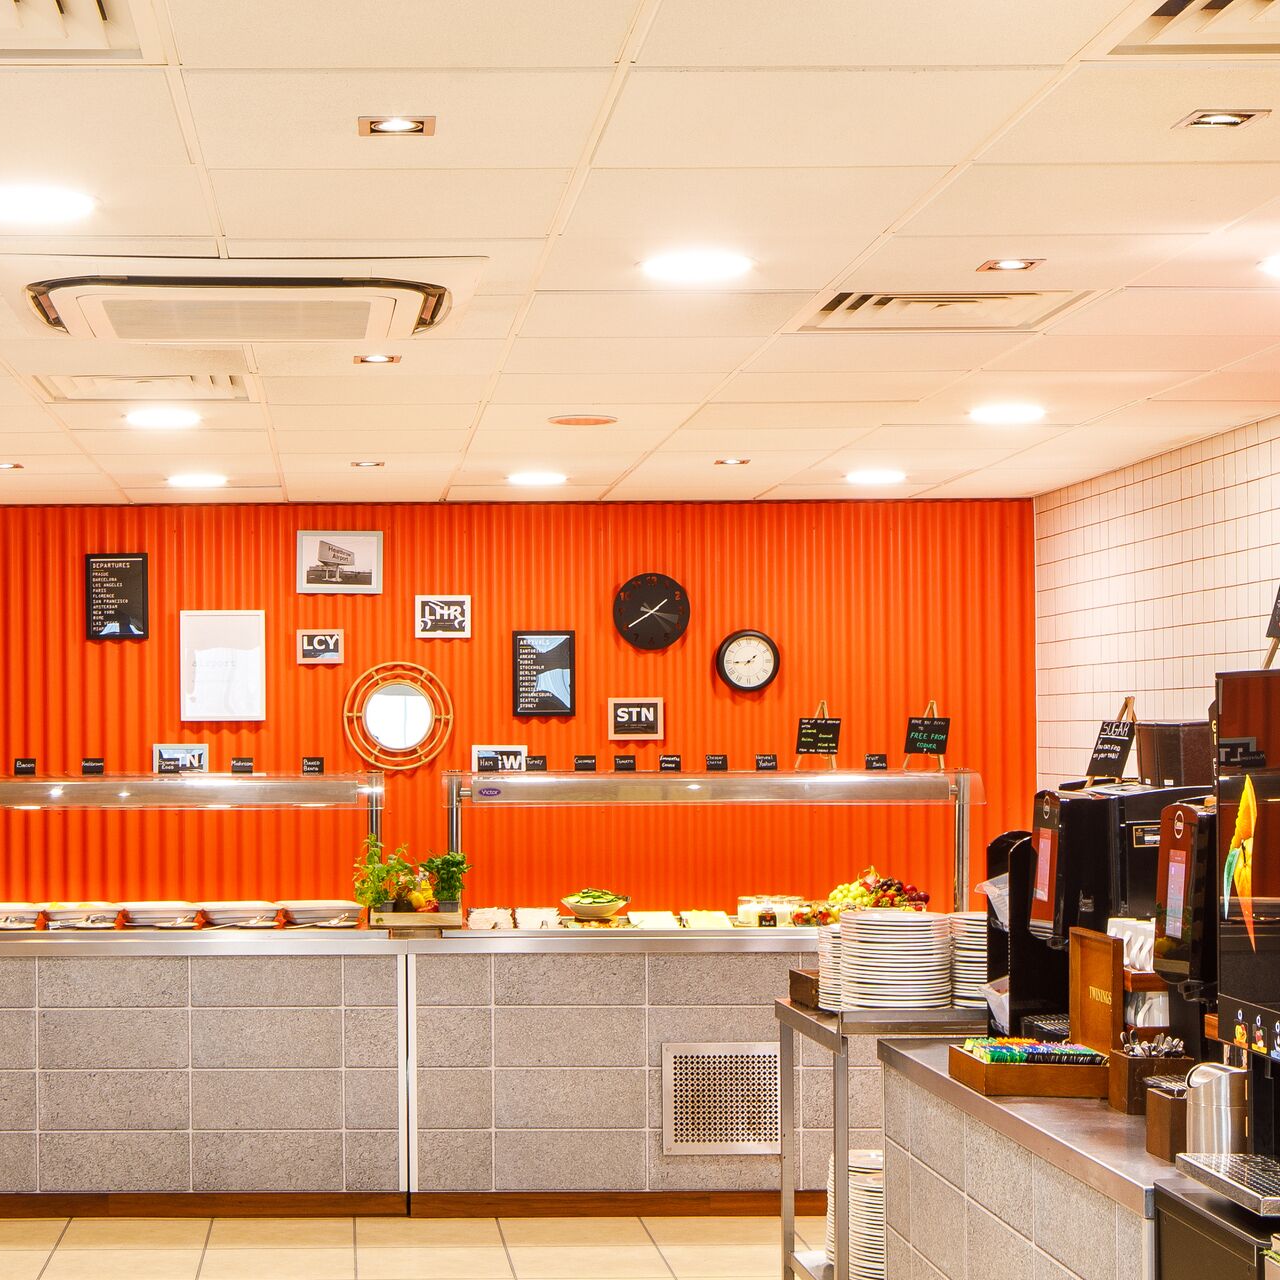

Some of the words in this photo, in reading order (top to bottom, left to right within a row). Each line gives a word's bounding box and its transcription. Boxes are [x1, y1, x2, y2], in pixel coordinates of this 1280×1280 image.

[328, 545, 351, 557] Heathrow
[332, 553, 349, 562] Airport
[425, 605, 463, 620] LHR
[303, 635, 338, 650] LCY
[616, 707, 654, 722] STN
[910, 732, 928, 740] FREE
[930, 733, 946, 741] FROM
[1100, 722, 1131, 737] SUGAR
[916, 742, 937, 750] CORNER
[1089, 985, 1112, 1006] TWININGS
